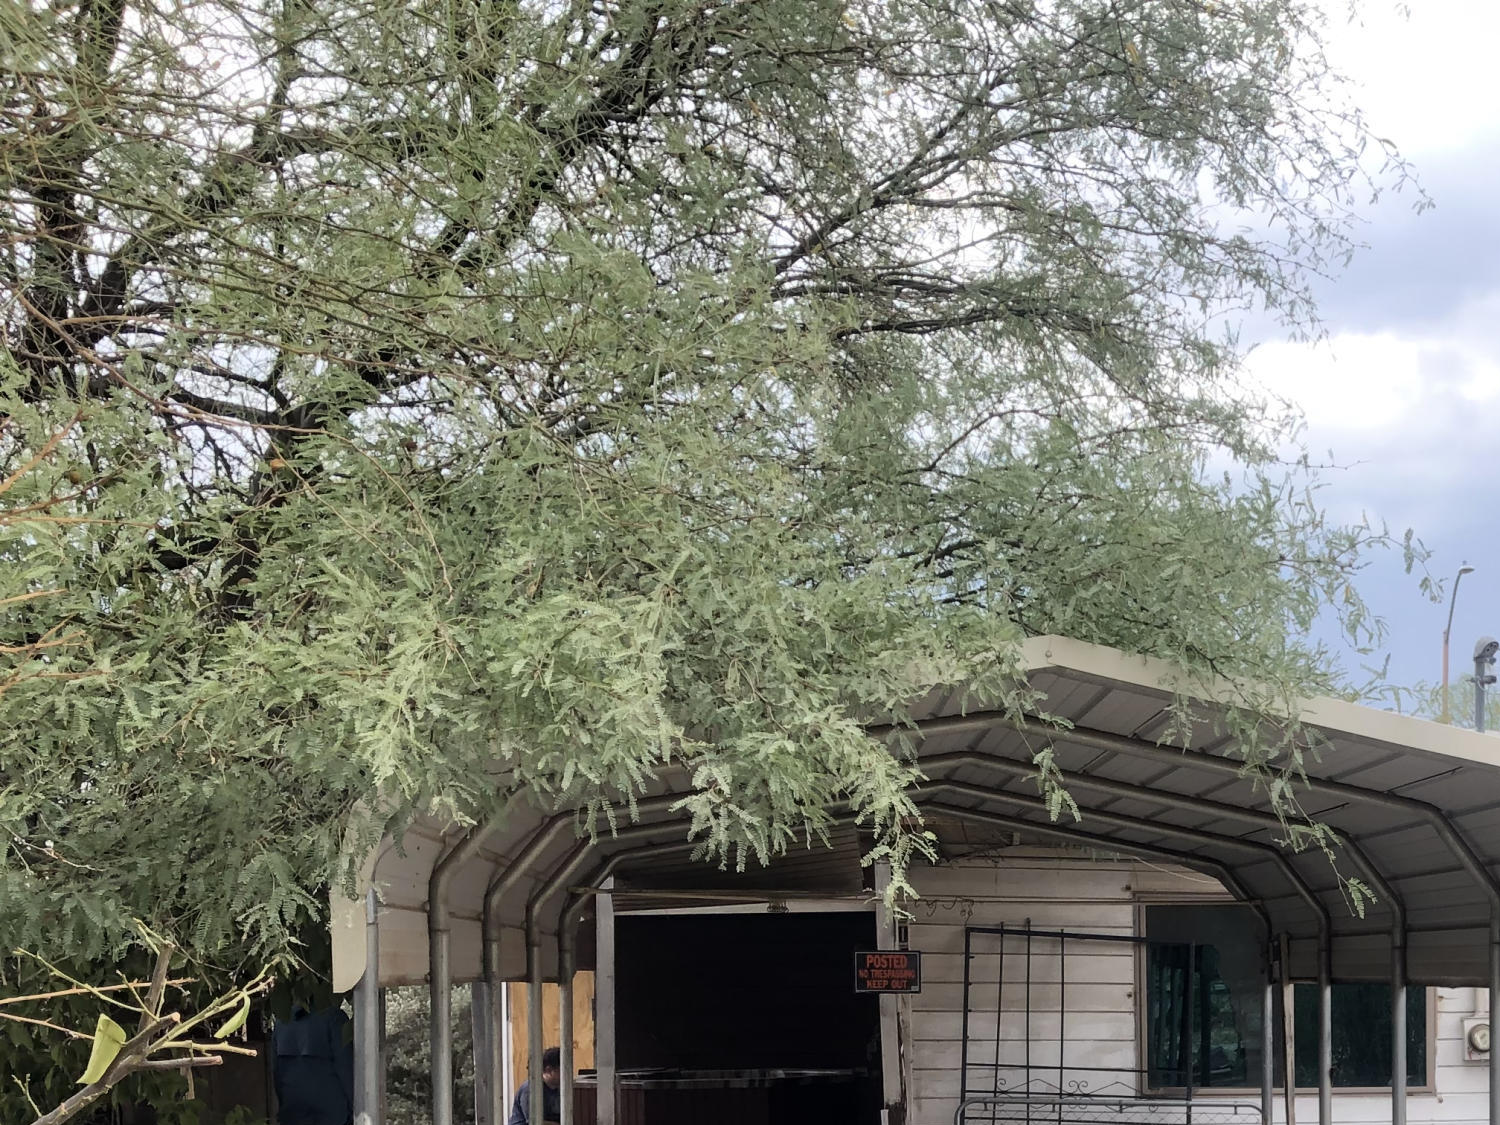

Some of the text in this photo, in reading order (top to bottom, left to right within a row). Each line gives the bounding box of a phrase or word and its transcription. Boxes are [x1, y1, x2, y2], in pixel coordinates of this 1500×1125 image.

[866, 954, 908, 968] POSTED
[858, 969, 869, 978] NO
[866, 980, 888, 989] KEEP
[891, 980, 907, 989] OUT
